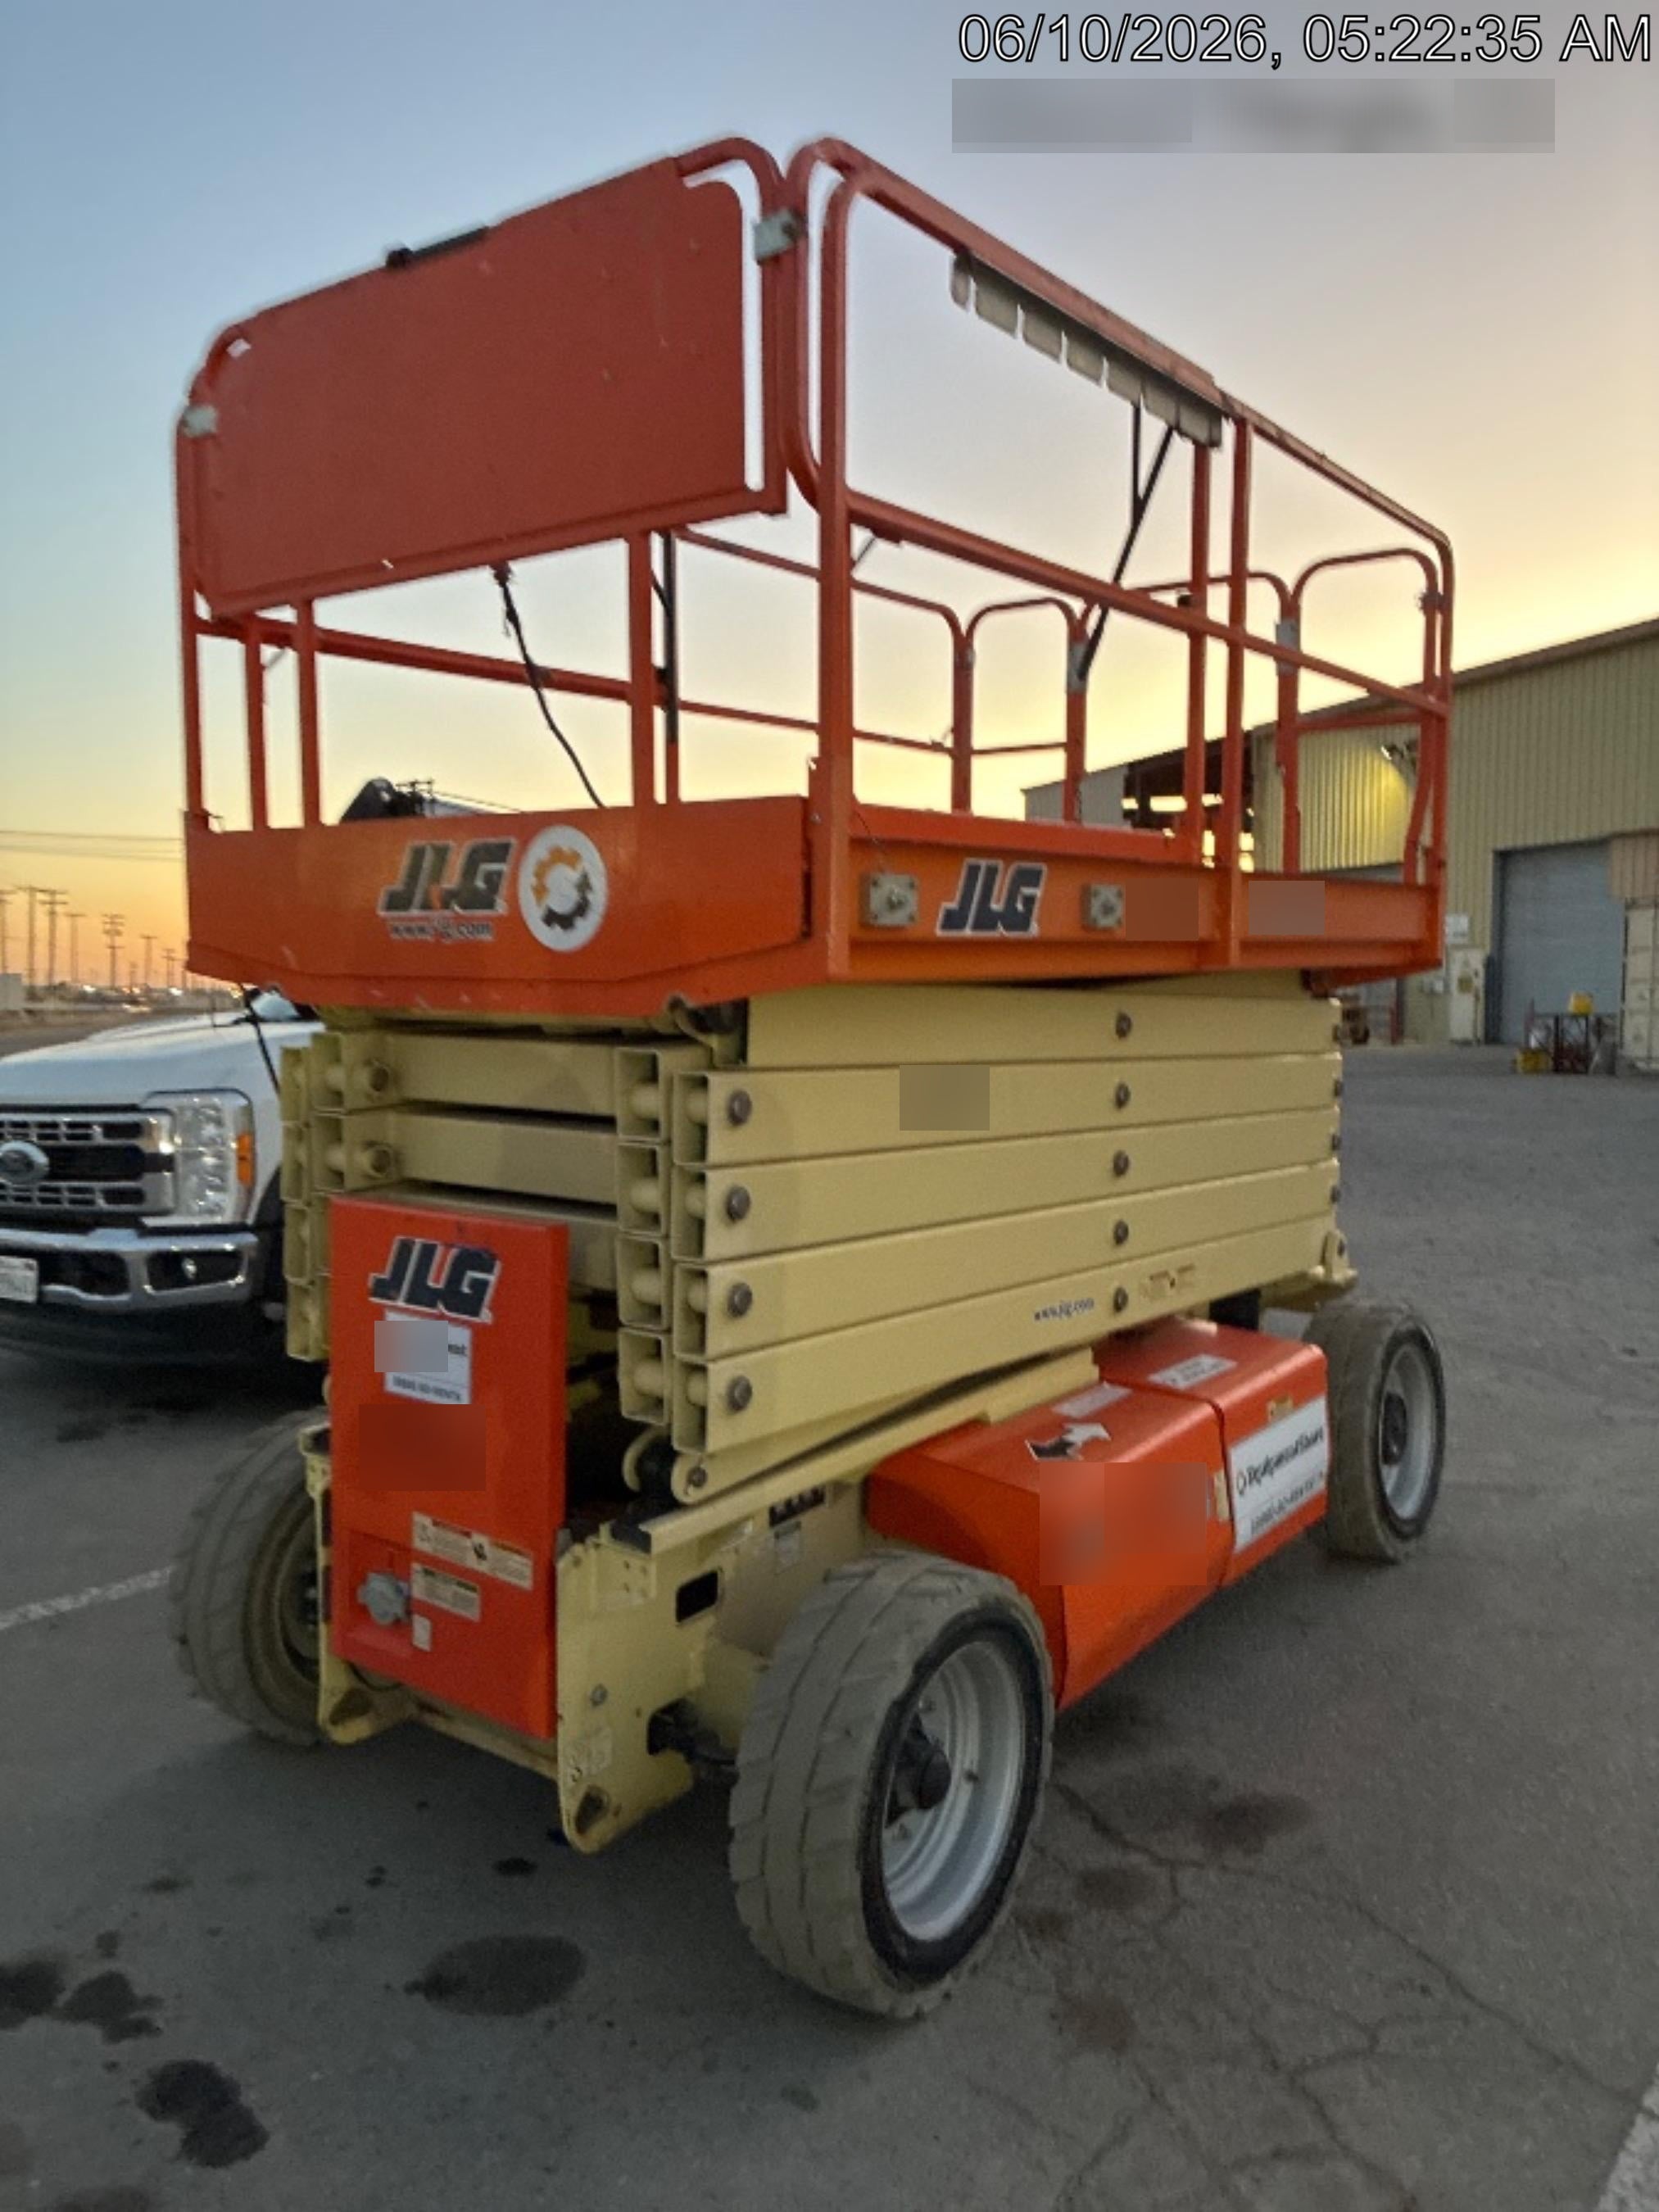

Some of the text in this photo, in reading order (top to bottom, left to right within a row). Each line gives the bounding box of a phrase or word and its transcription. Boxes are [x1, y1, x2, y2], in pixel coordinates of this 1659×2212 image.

[378, 837, 515, 914] JLG
[937, 858, 1046, 937] JLG
[369, 1235, 501, 1324] JLG
